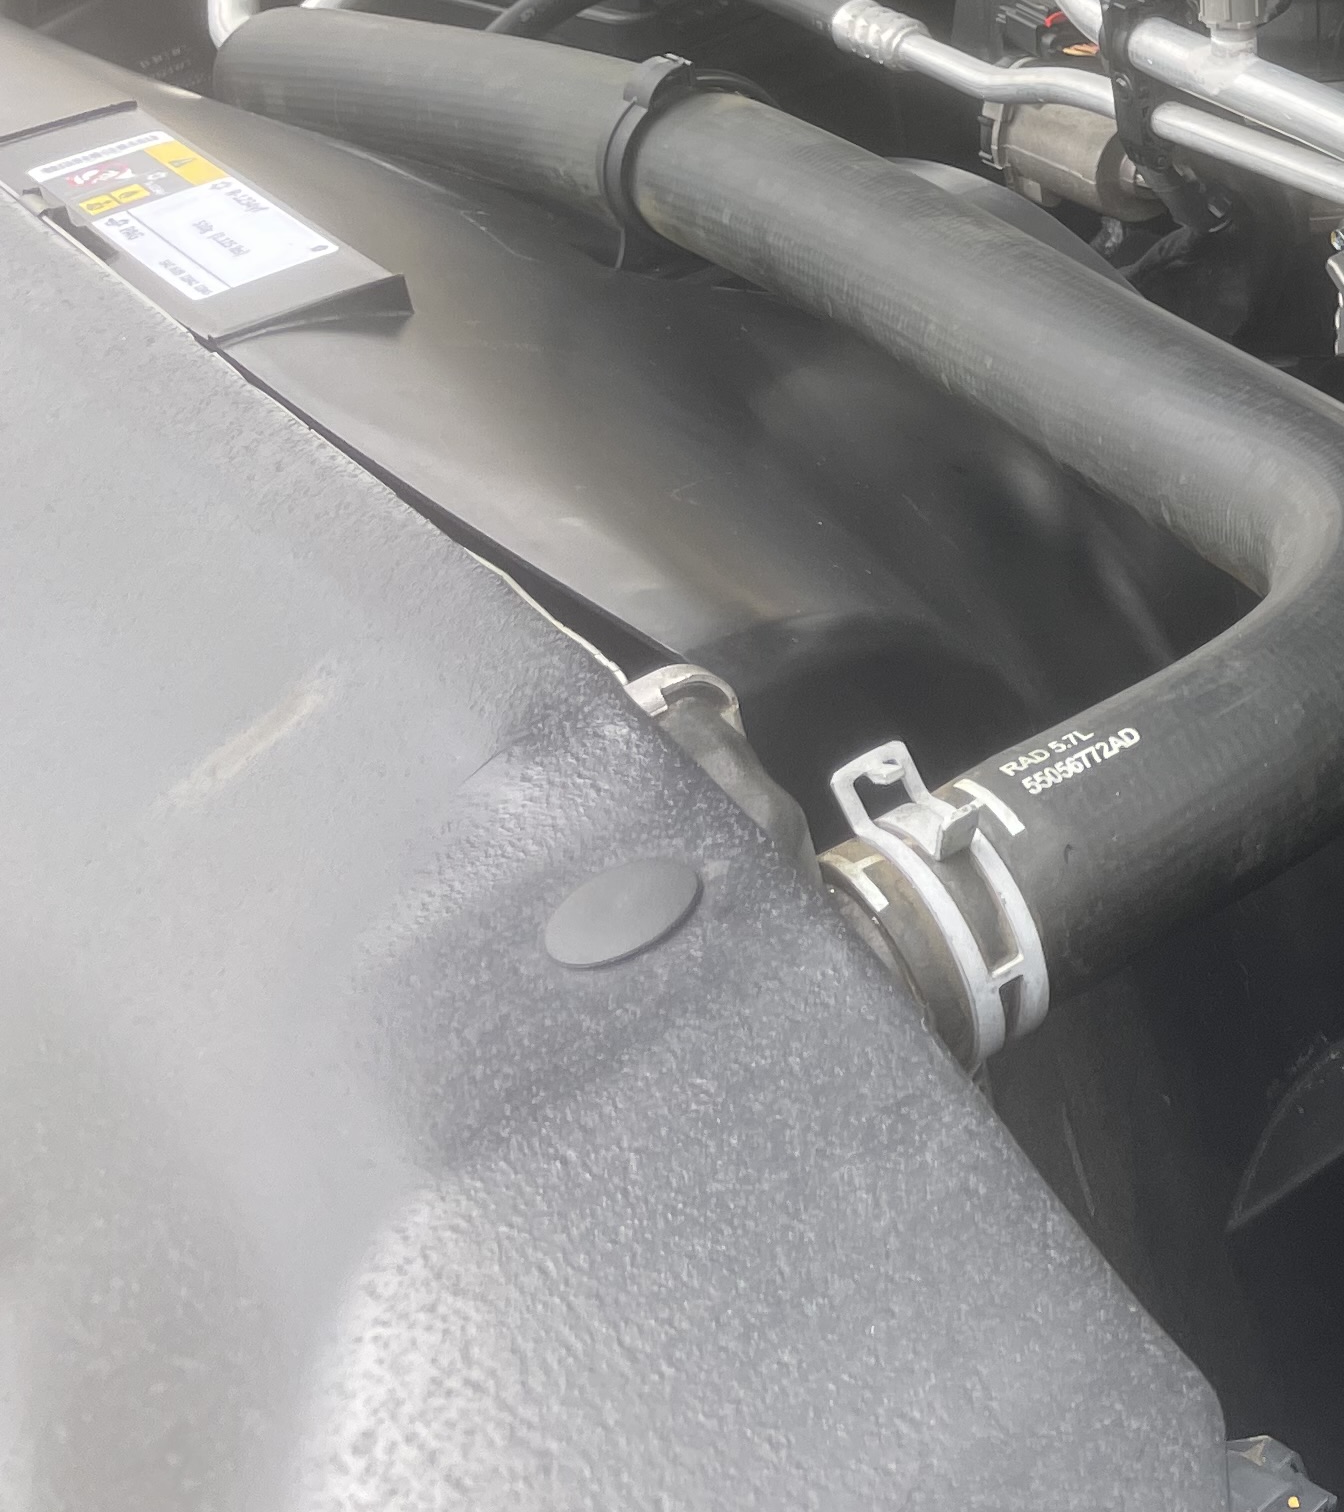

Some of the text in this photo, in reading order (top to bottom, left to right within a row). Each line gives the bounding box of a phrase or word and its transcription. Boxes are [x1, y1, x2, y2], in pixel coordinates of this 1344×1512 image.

[999, 730, 1095, 777] RAD 5.7L
[1021, 727, 1141, 795] 55056772AD
